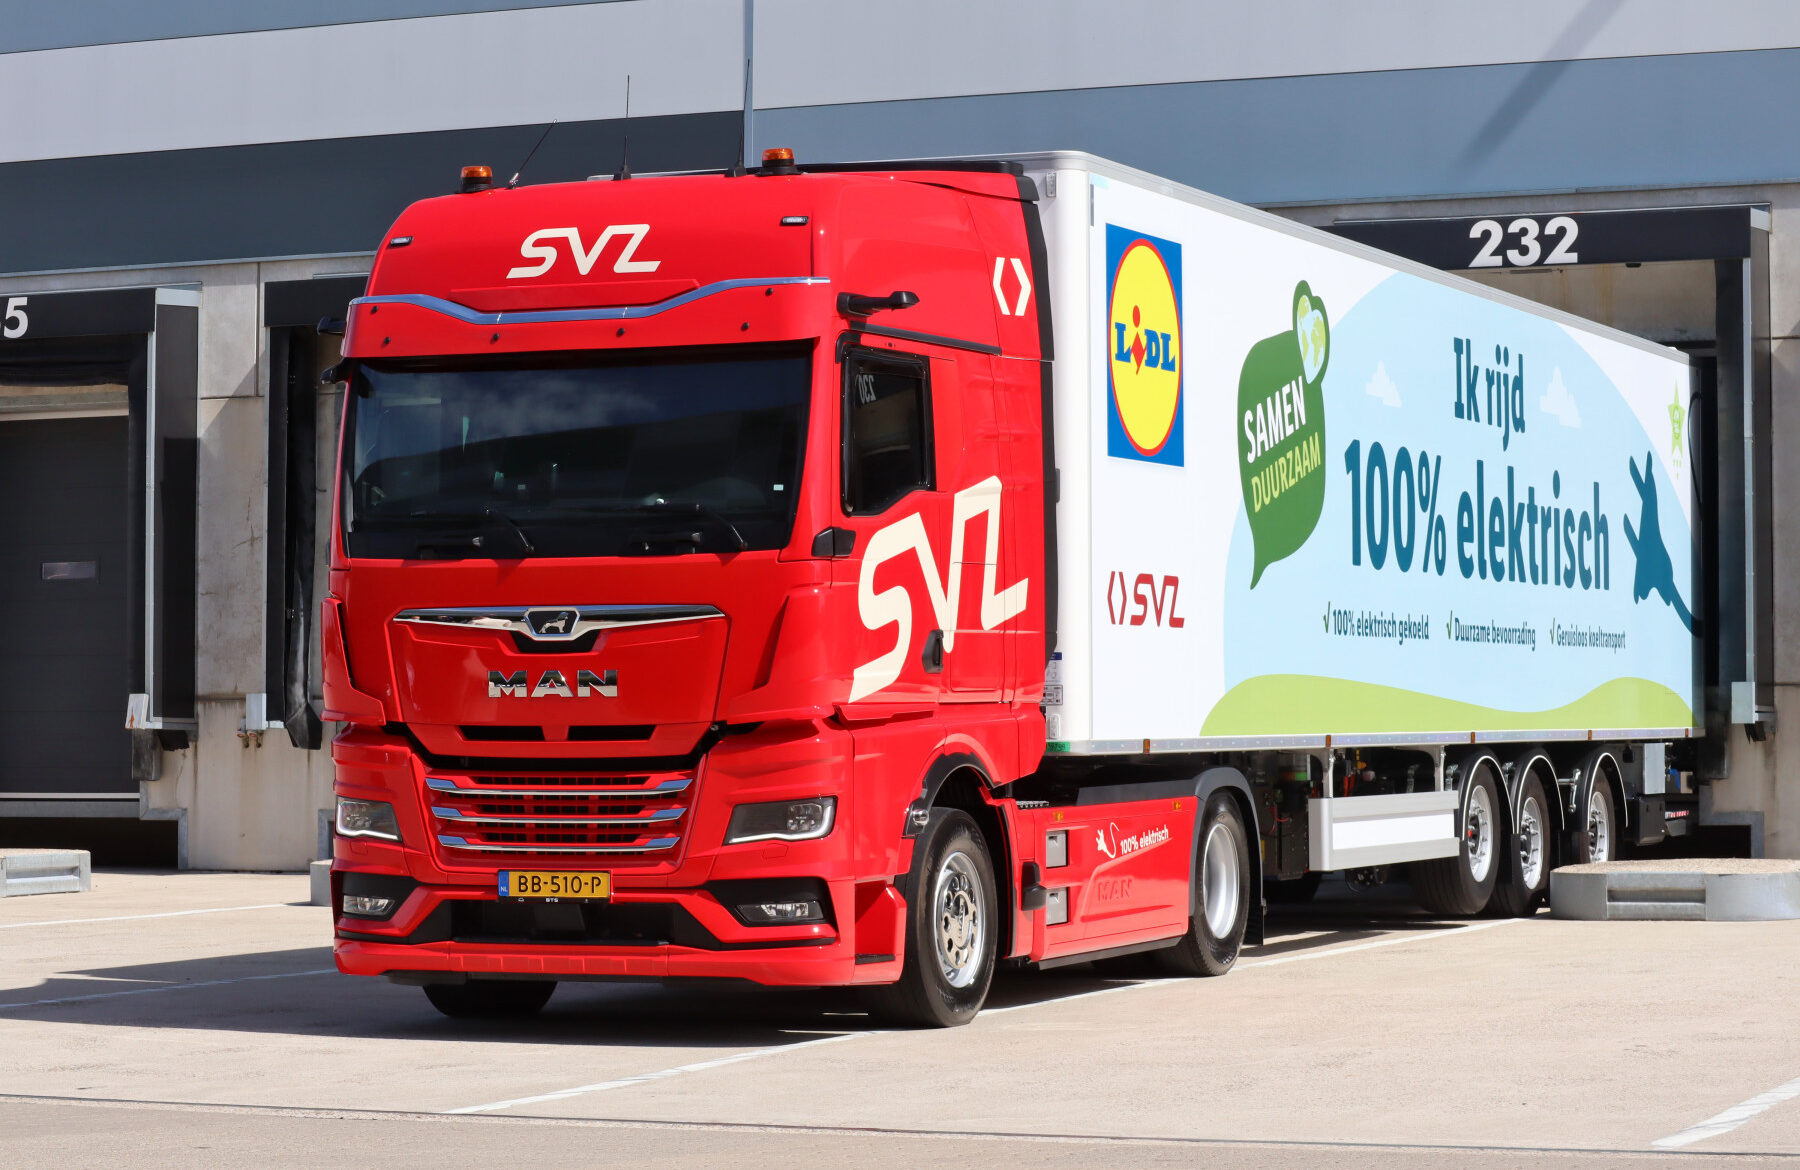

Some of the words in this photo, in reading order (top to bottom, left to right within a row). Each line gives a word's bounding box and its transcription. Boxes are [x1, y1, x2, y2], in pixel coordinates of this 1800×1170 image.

[506, 223, 662, 280] SVZ
[1469, 216, 1579, 268] 232
[0, 296, 29, 339] 5
[1453, 337, 1481, 424] Ik
[1484, 344, 1526, 451] rijd
[1244, 376, 1306, 463] SAMEN
[1251, 431, 1321, 513] DUURZAAM
[1344, 439, 1447, 576] 100%
[1456, 460, 1610, 590] elektrisch
[848, 475, 1029, 704] SVZ
[1130, 573, 1185, 629] SVZ
[1333, 608, 1354, 637] 100%
[1357, 610, 1397, 638] elektrisch
[1399, 613, 1429, 645] gekoeld
[1454, 617, 1490, 643] Duurzame
[1491, 619, 1536, 651] bevoorrading
[1556, 623, 1588, 647] Geruisloos
[1589, 625, 1626, 654] koeltransport
[487, 670, 618, 698] MAN
[1120, 835, 1139, 855] 100%
[1139, 824, 1169, 848] elektrisch
[518, 875, 602, 894] BB-510-P
[1098, 878, 1132, 901] MAN
